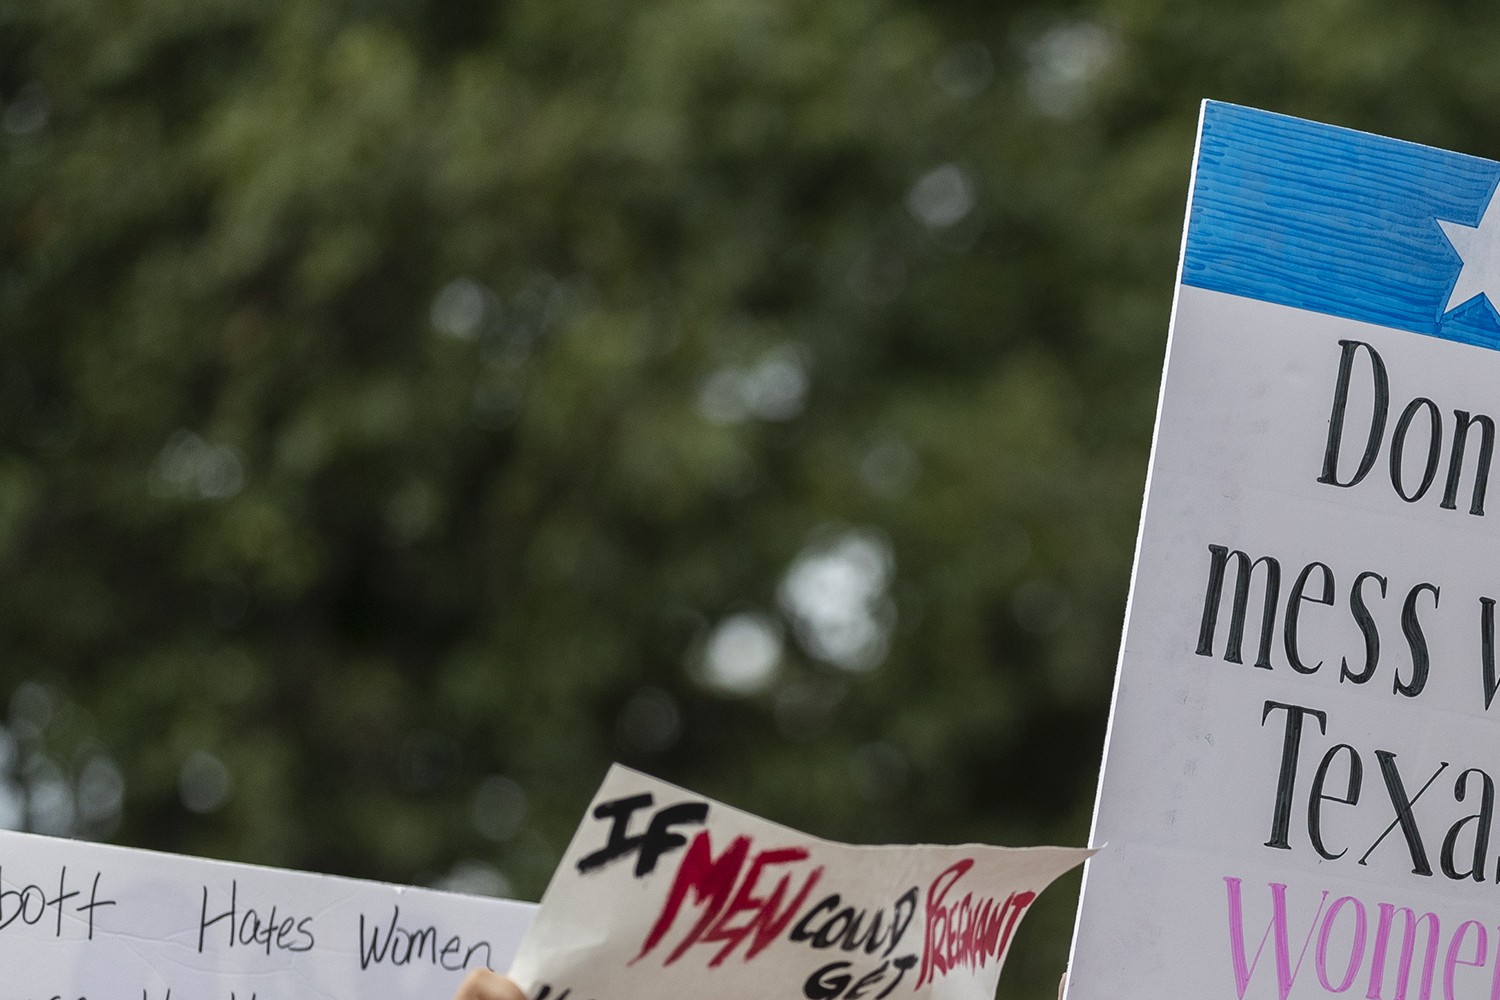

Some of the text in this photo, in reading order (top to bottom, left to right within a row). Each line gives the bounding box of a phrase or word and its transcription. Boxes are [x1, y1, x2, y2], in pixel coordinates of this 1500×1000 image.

[1195, 544, 1440, 698] mess
[577, 793, 709, 878] IF
[627, 830, 825, 968] MEN
[0, 865, 495, 972] bott Hates Women
[913, 858, 1036, 992] PREGNANT
